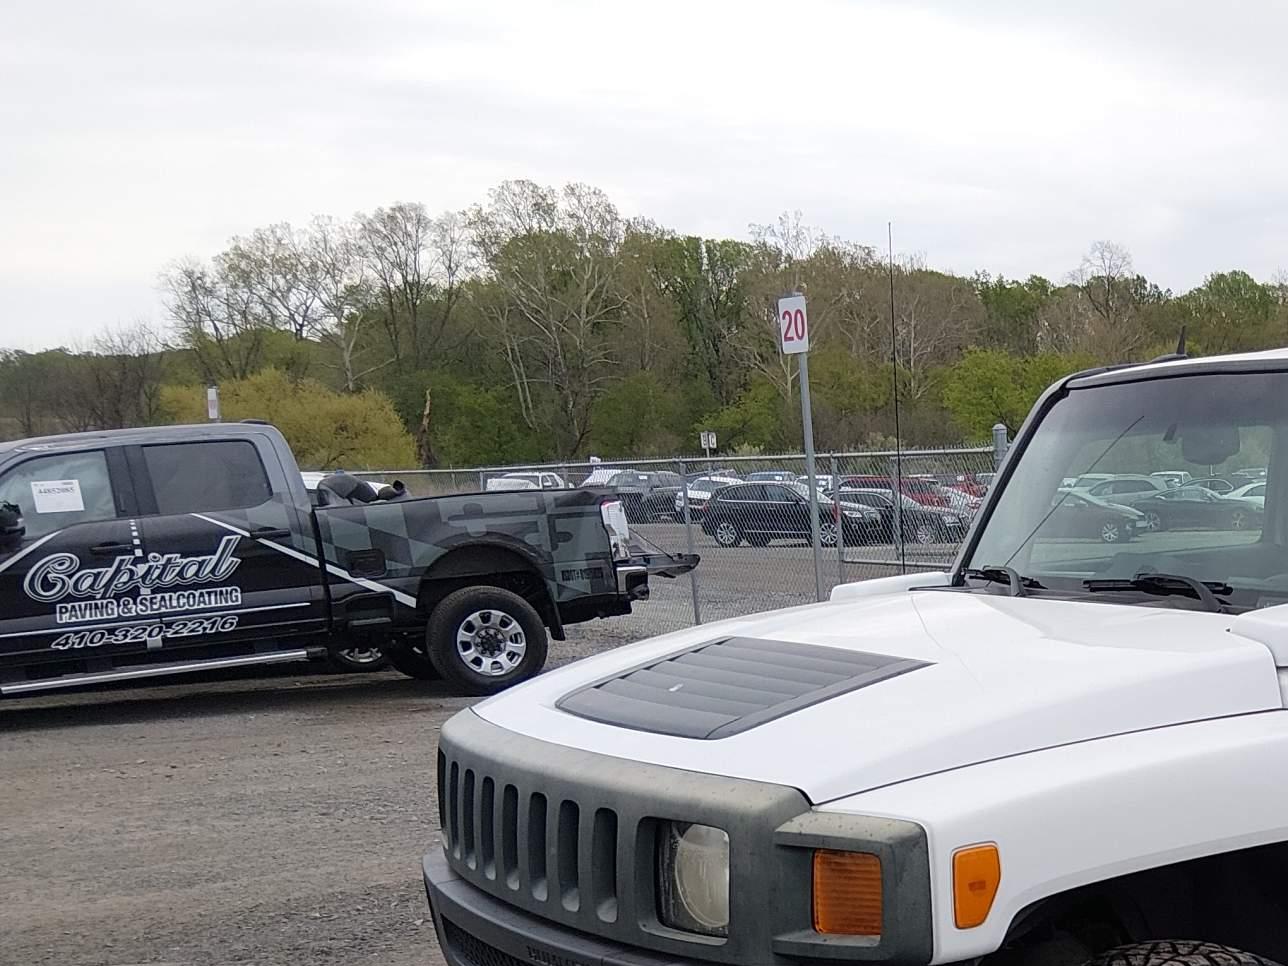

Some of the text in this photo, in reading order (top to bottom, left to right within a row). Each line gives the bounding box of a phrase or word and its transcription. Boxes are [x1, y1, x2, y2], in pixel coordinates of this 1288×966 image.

[781, 308, 806, 343] 20
[23, 535, 243, 602] Capital
[56, 587, 242, 624] PAVING & SEALCOATING
[51, 616, 238, 650] 410-320-2216
